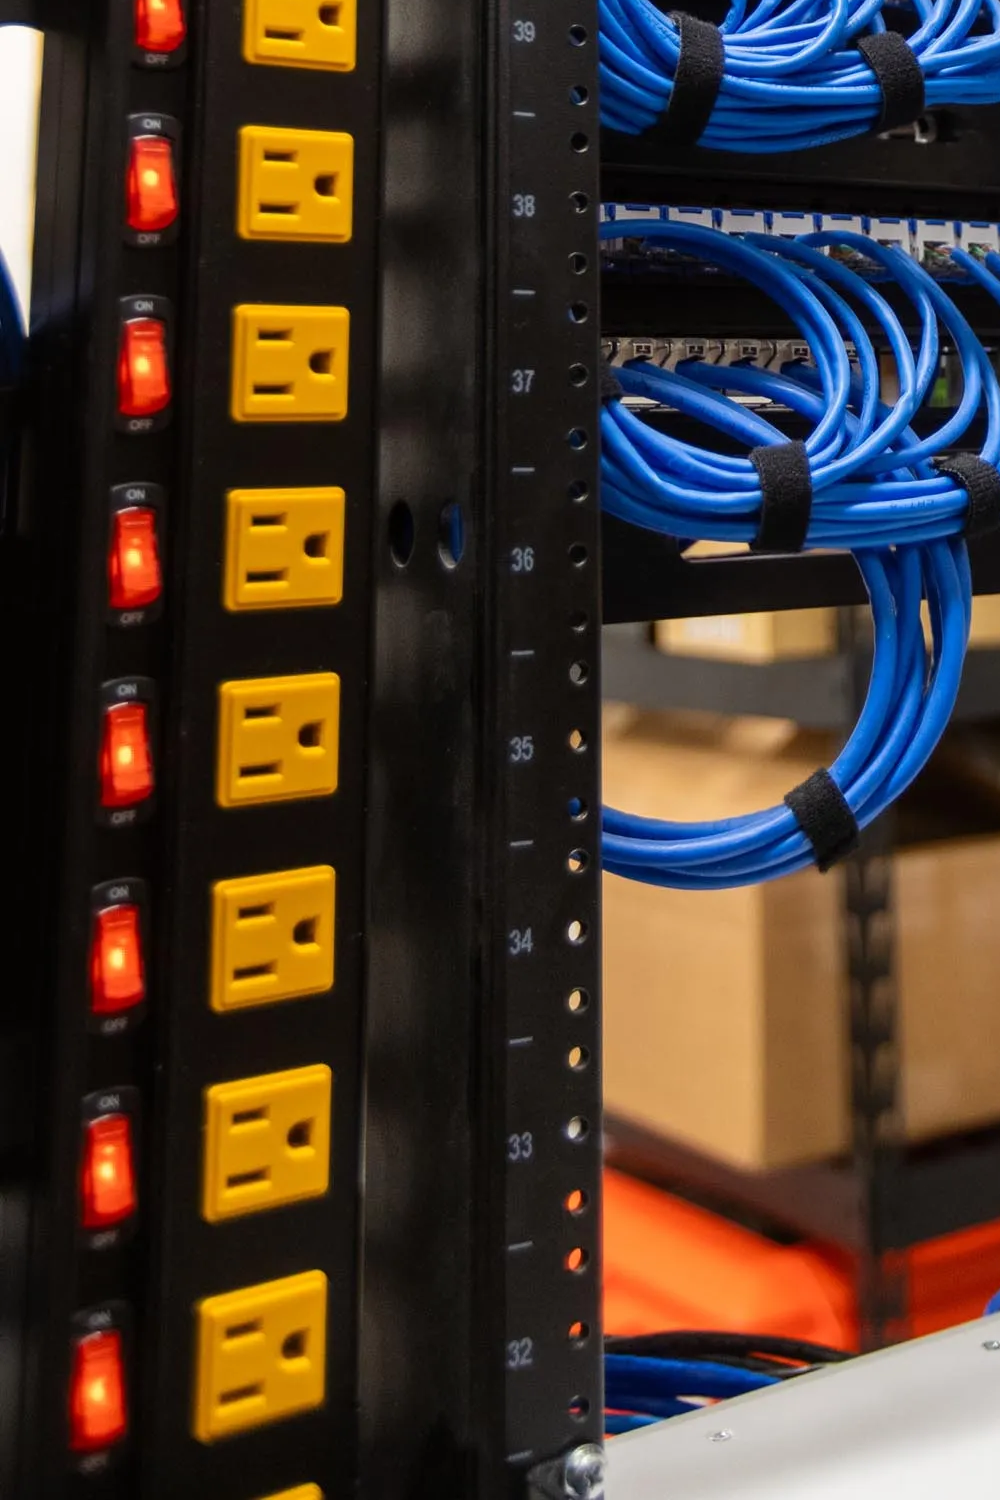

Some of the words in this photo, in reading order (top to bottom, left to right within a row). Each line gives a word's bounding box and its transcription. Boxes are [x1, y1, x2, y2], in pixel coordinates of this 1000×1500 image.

[514, 21, 535, 42] 39
[146, 53, 168, 64] OFF
[144, 120, 161, 129] ON
[513, 194, 535, 217] 38
[138, 234, 160, 244] OFF
[135, 301, 153, 311] ON
[513, 370, 534, 392] 37
[130, 420, 152, 430] OFF
[126, 489, 145, 499] ON
[512, 548, 533, 571] 36
[121, 612, 144, 624] OFF
[118, 684, 136, 695] ON
[511, 736, 533, 761] 35
[112, 811, 136, 823] OFF
[110, 886, 128, 898] ON
[509, 928, 533, 955] 34
[103, 1019, 128, 1031] OFF
[99, 1095, 120, 1109] ON
[508, 1132, 532, 1160] 33
[508, 1338, 532, 1367] 32
